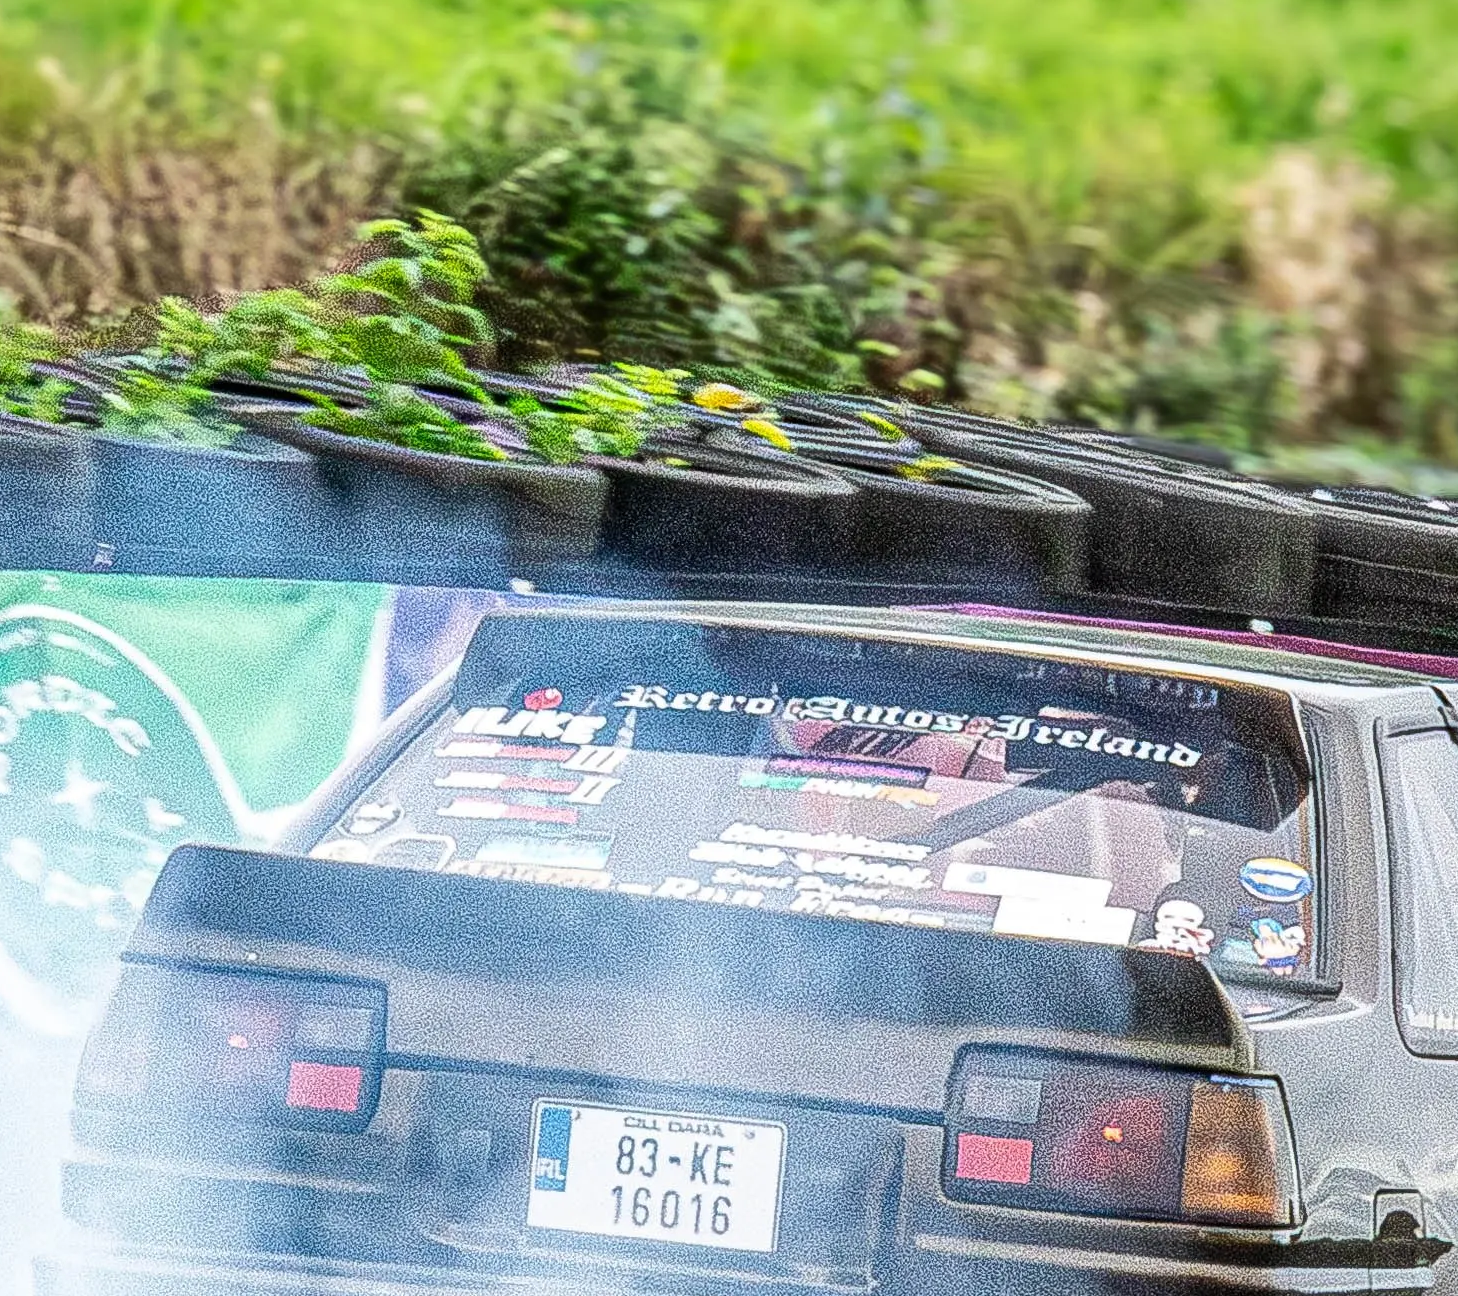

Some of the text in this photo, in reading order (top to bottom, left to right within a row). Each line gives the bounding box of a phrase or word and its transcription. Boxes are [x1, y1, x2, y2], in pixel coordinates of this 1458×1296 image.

[615, 683, 1202, 768] Retro Autos Ireland
[615, 1133, 735, 1186] 83-KE
[611, 1184, 733, 1236] 16016
